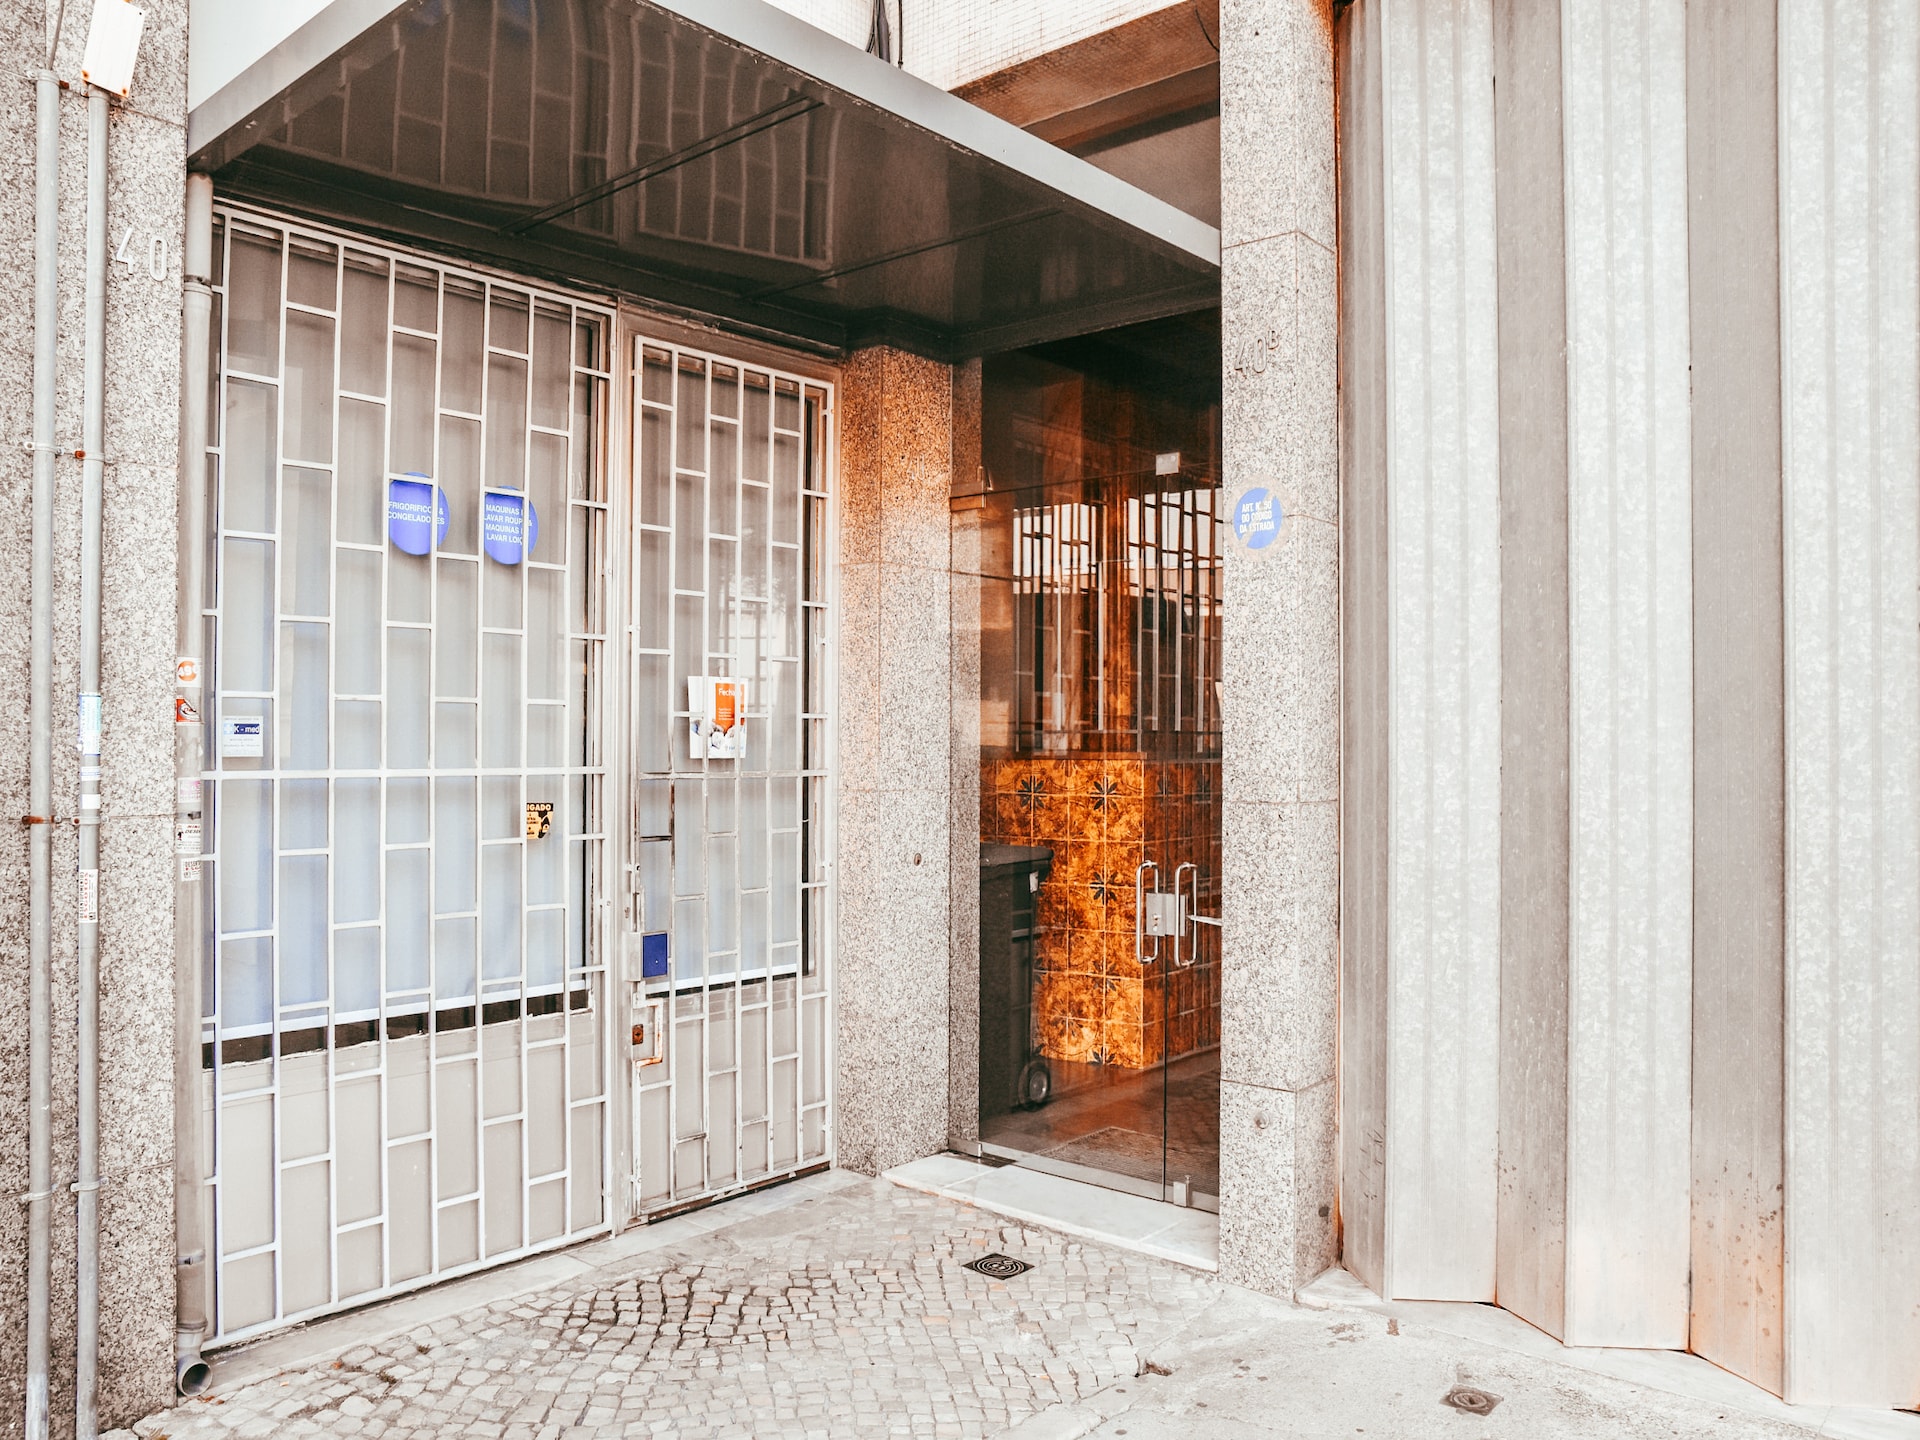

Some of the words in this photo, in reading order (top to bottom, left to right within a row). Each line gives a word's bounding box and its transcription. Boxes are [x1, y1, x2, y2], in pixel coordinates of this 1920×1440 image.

[115, 227, 168, 282] 40
[388, 501, 436, 514] FRIGORIFICO
[486, 504, 519, 515] MAQUINAS
[388, 511, 445, 525] CONGELADOES
[504, 516, 525, 525] ROUP
[486, 524, 519, 534] MAQUINAS
[487, 533, 507, 542] LAVAR
